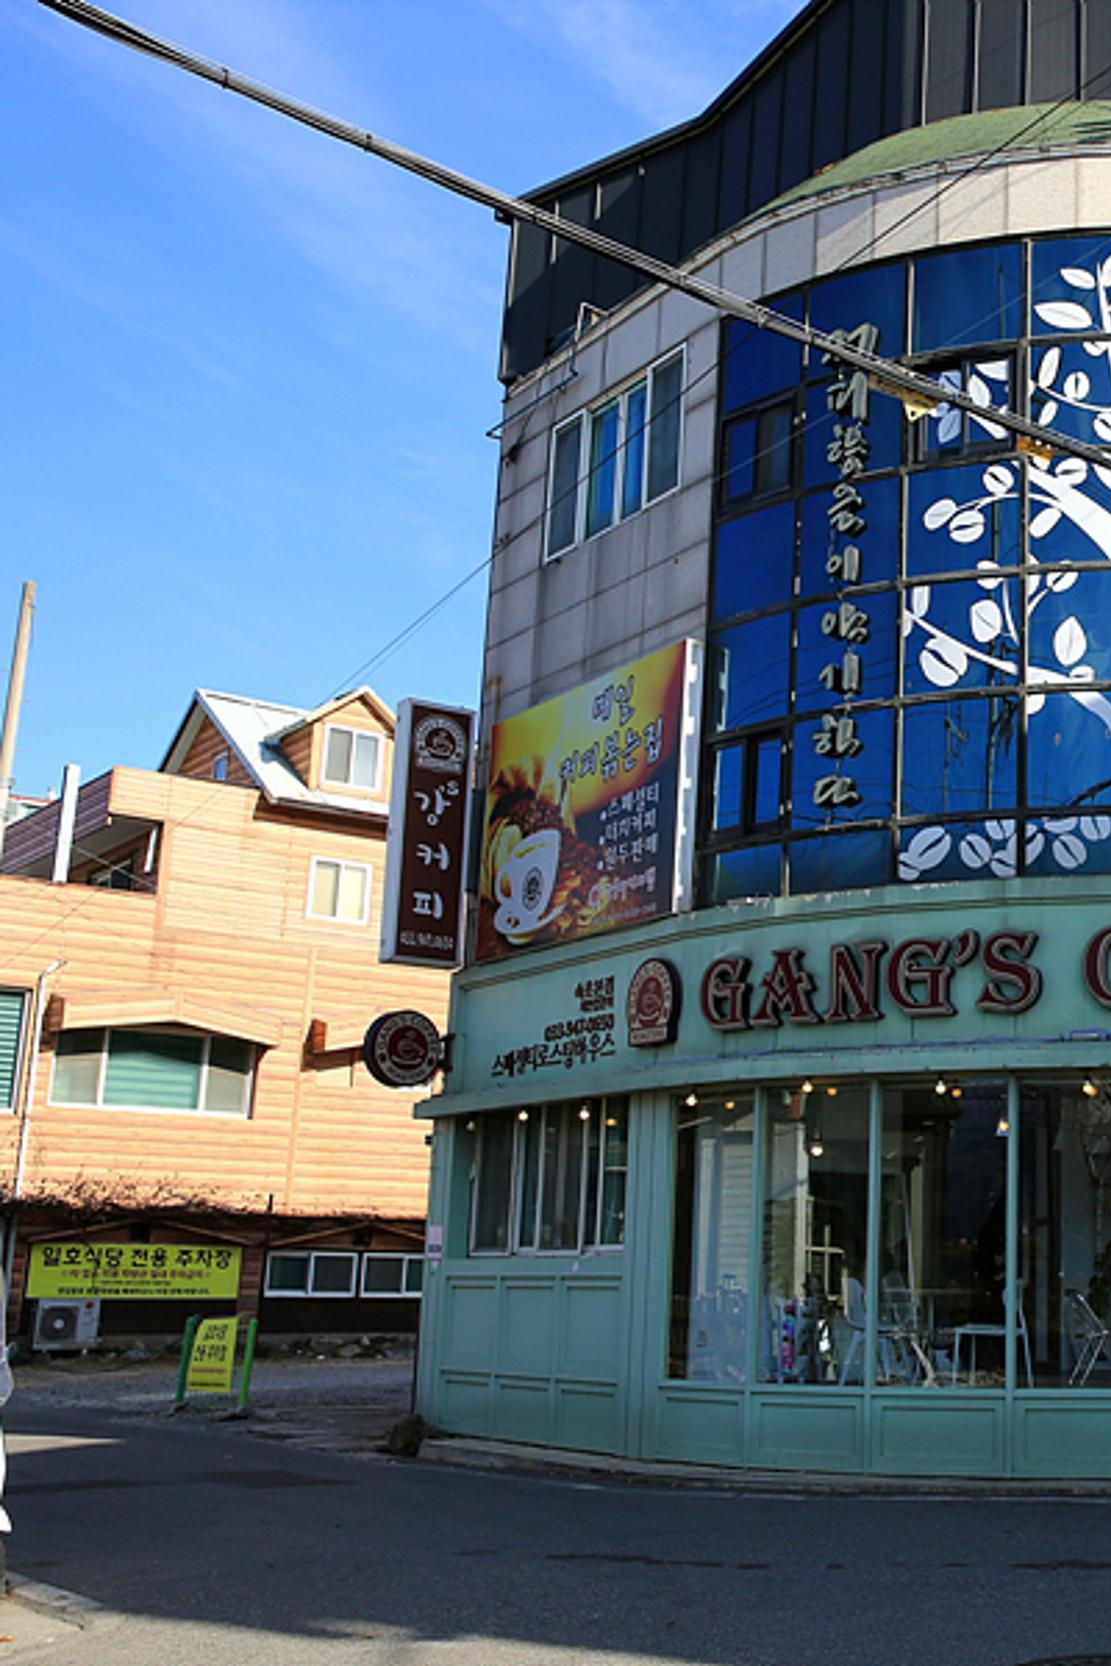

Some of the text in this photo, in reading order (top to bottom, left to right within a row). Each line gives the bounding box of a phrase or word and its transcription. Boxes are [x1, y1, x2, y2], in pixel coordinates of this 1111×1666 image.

[700, 928, 1042, 1032] GANG'S
[41, 1246, 233, 1270] 일호식당 전용 주차장
